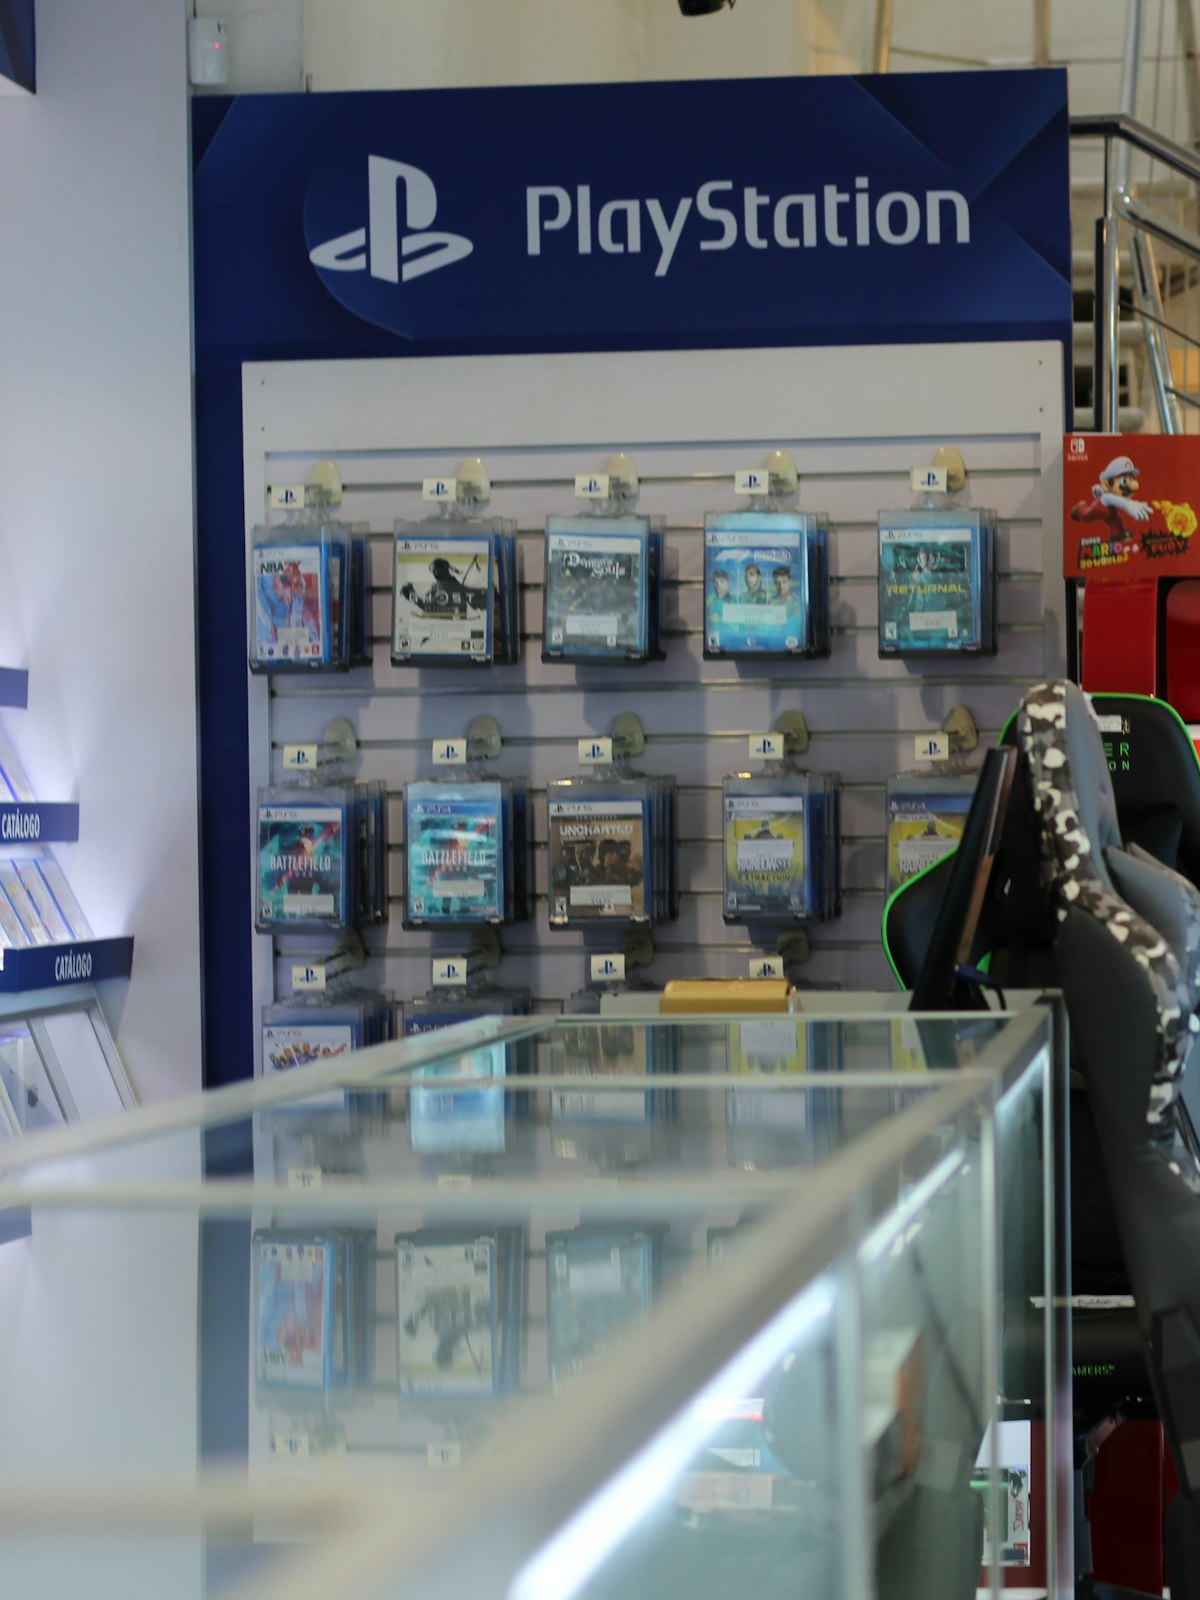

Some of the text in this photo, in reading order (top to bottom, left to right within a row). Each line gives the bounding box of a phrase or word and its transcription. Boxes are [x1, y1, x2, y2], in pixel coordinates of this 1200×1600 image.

[526, 176, 970, 277] PlayStation
[1081, 541, 1123, 560] MARIO
[260, 563, 284, 574] NBA
[887, 583, 966, 595] RETURNAL
[1, 808, 41, 840] CATÁLOGO
[559, 824, 634, 836] UNCHARTED
[270, 855, 331, 871] BATTLEFIELD
[421, 850, 486, 866] BATTLEFIELD
[55, 948, 93, 981] CATÁLOGO
